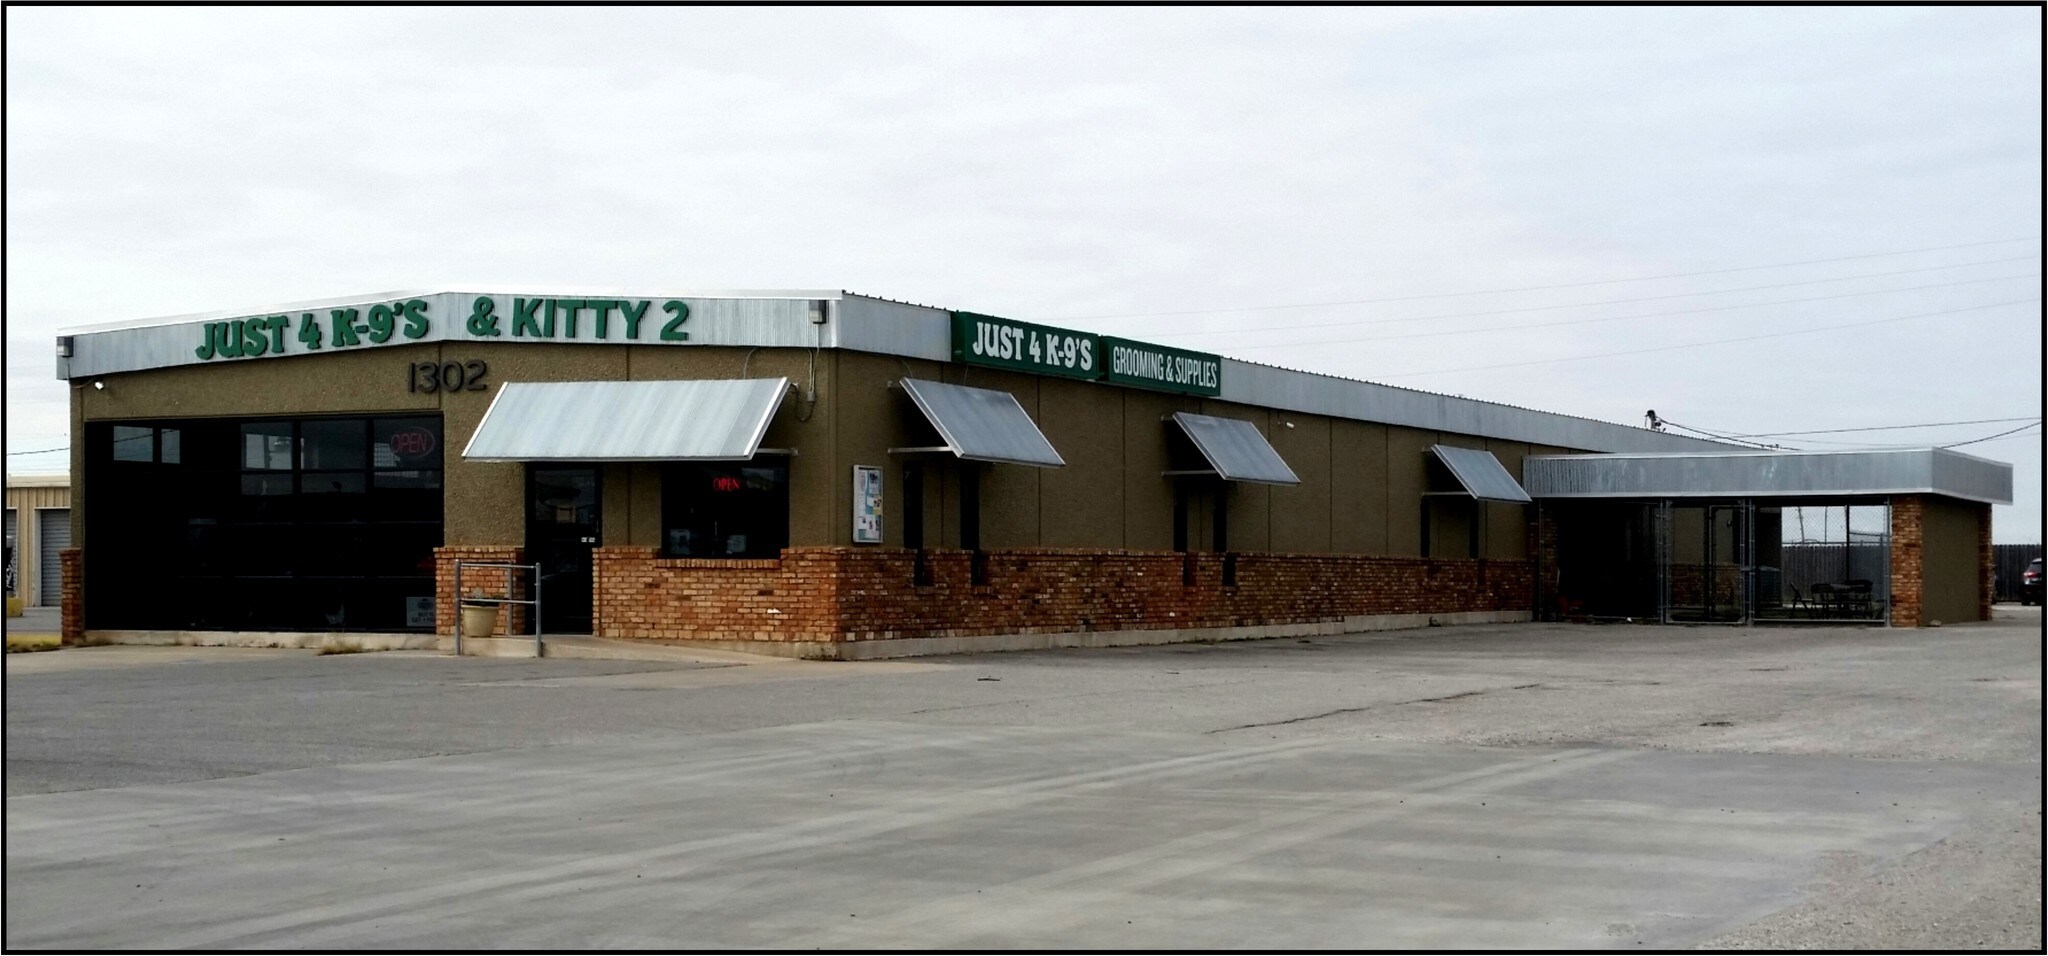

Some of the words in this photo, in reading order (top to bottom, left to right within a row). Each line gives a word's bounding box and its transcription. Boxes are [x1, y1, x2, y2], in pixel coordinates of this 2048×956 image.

[194, 314, 288, 361] JUST
[296, 313, 321, 351] 4
[327, 298, 430, 348] K-9'S
[465, 296, 500, 337] &
[508, 295, 649, 340] KITTY
[657, 299, 690, 342] 2
[972, 321, 1024, 361] JUST
[1029, 331, 1041, 363] 4
[1046, 333, 1093, 371] K-9'S
[1113, 346, 1164, 381] GROOMING
[1165, 355, 1174, 382] &
[1175, 357, 1218, 388] SUPPLIES
[408, 360, 488, 393] 1302
[390, 432, 427, 453] OPEN
[713, 478, 739, 491] OPEN
